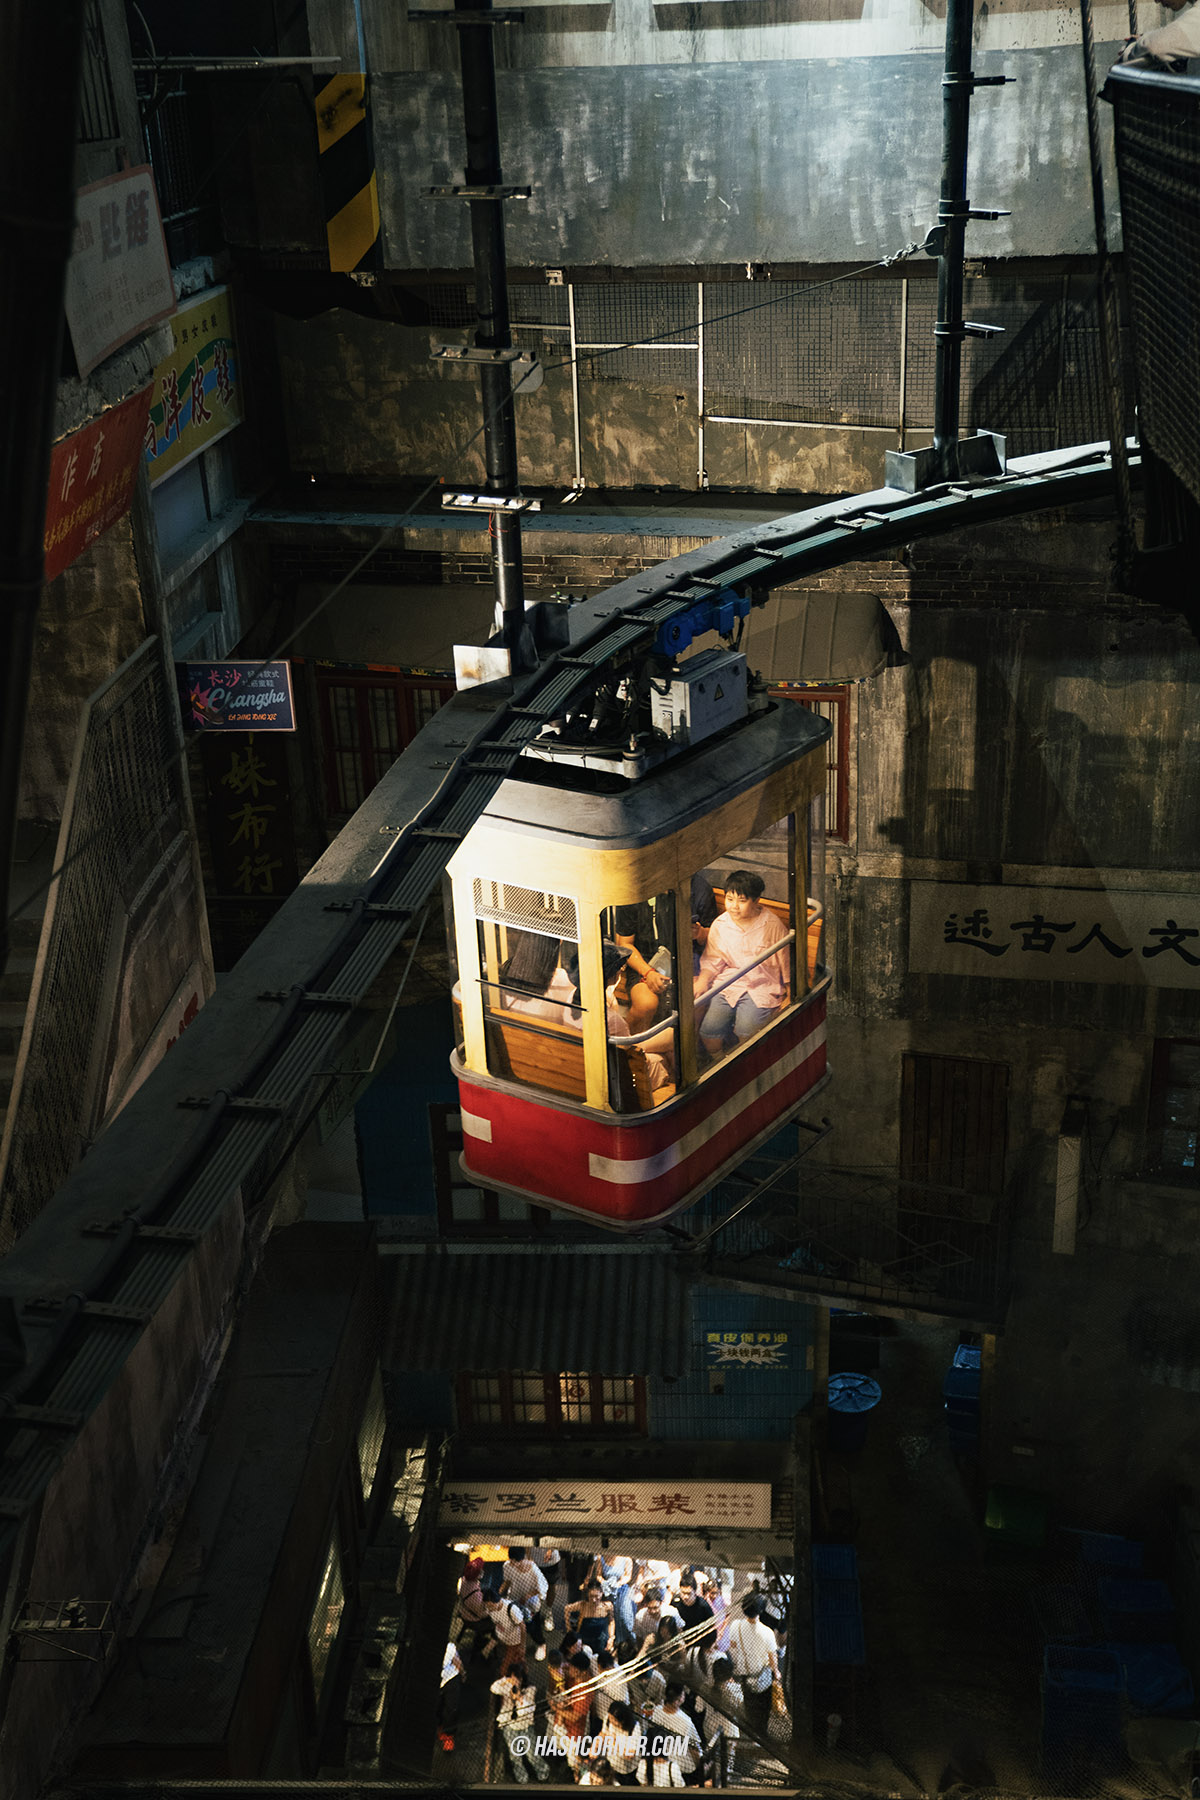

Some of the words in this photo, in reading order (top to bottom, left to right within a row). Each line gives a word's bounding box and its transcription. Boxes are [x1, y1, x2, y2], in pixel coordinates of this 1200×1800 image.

[208, 668, 242, 688] 长沙
[441, 1492, 697, 1516] 紫罗兰服装
